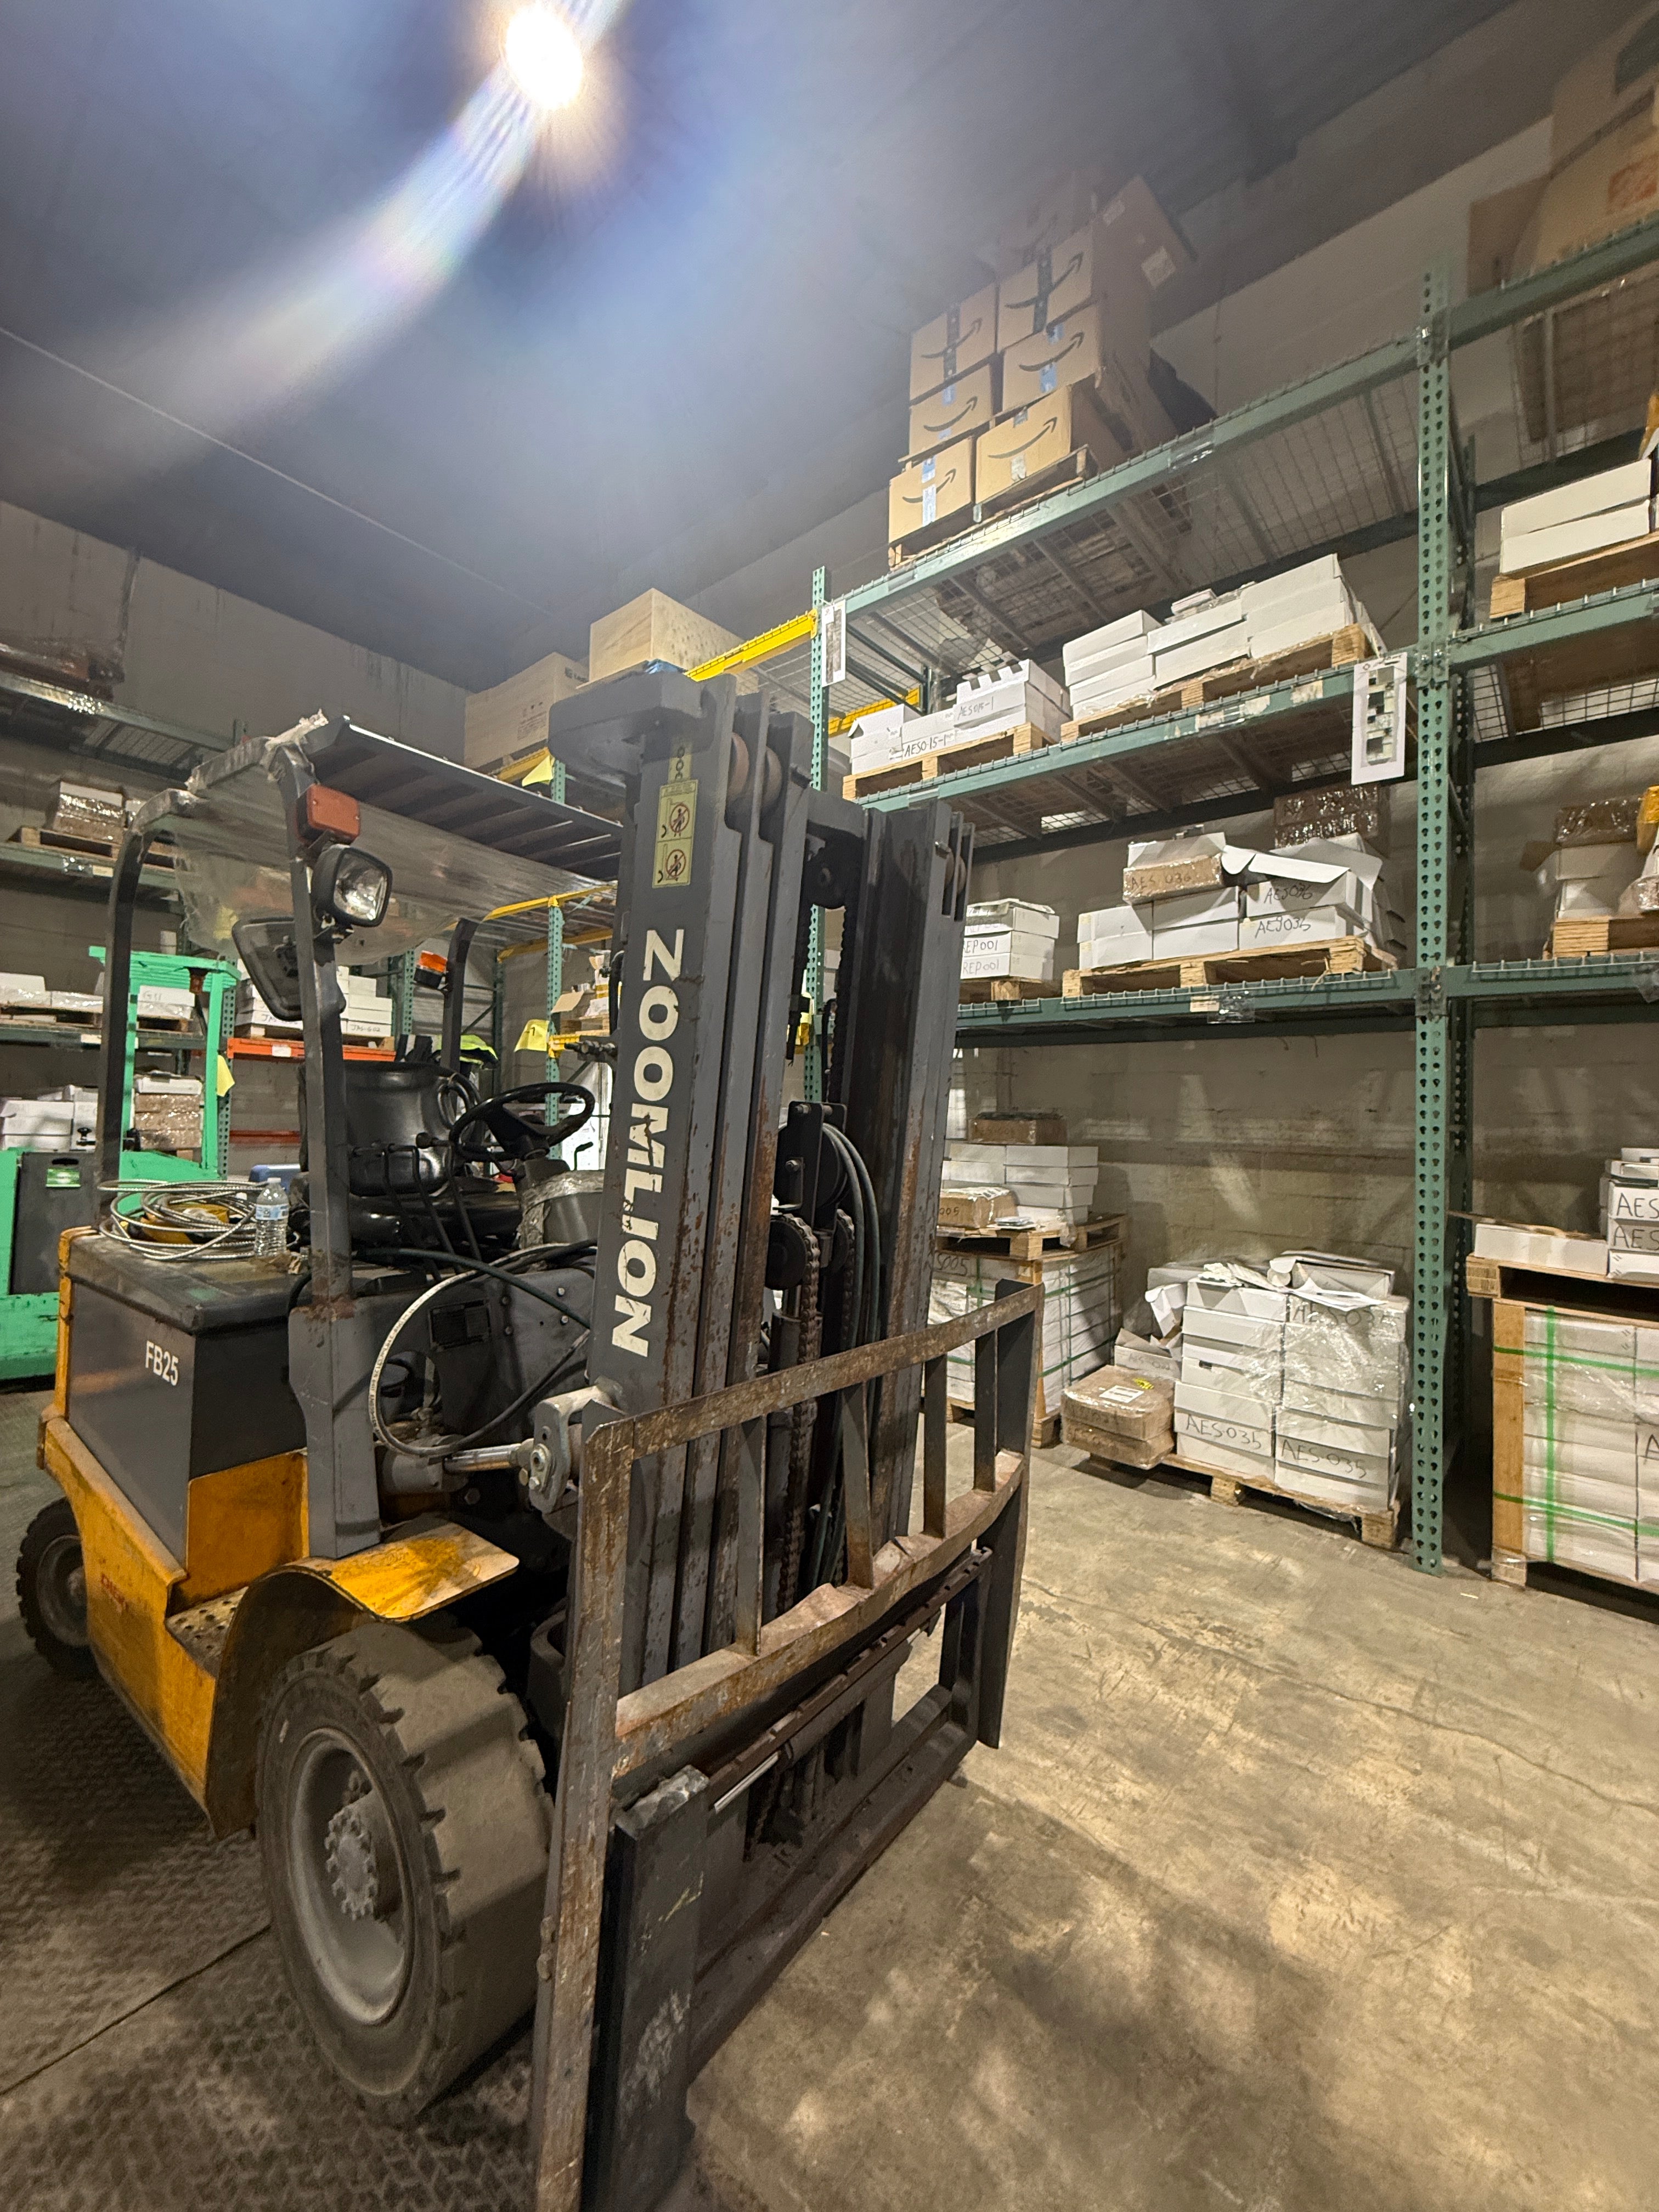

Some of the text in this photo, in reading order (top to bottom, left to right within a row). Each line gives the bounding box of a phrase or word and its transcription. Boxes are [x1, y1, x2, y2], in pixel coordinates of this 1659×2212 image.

[612, 928, 685, 1357] ZOOMLION
[1616, 1192, 1659, 1219] AES
[1613, 1224, 1659, 1251] AES
[145, 1340, 179, 1386] FB25
